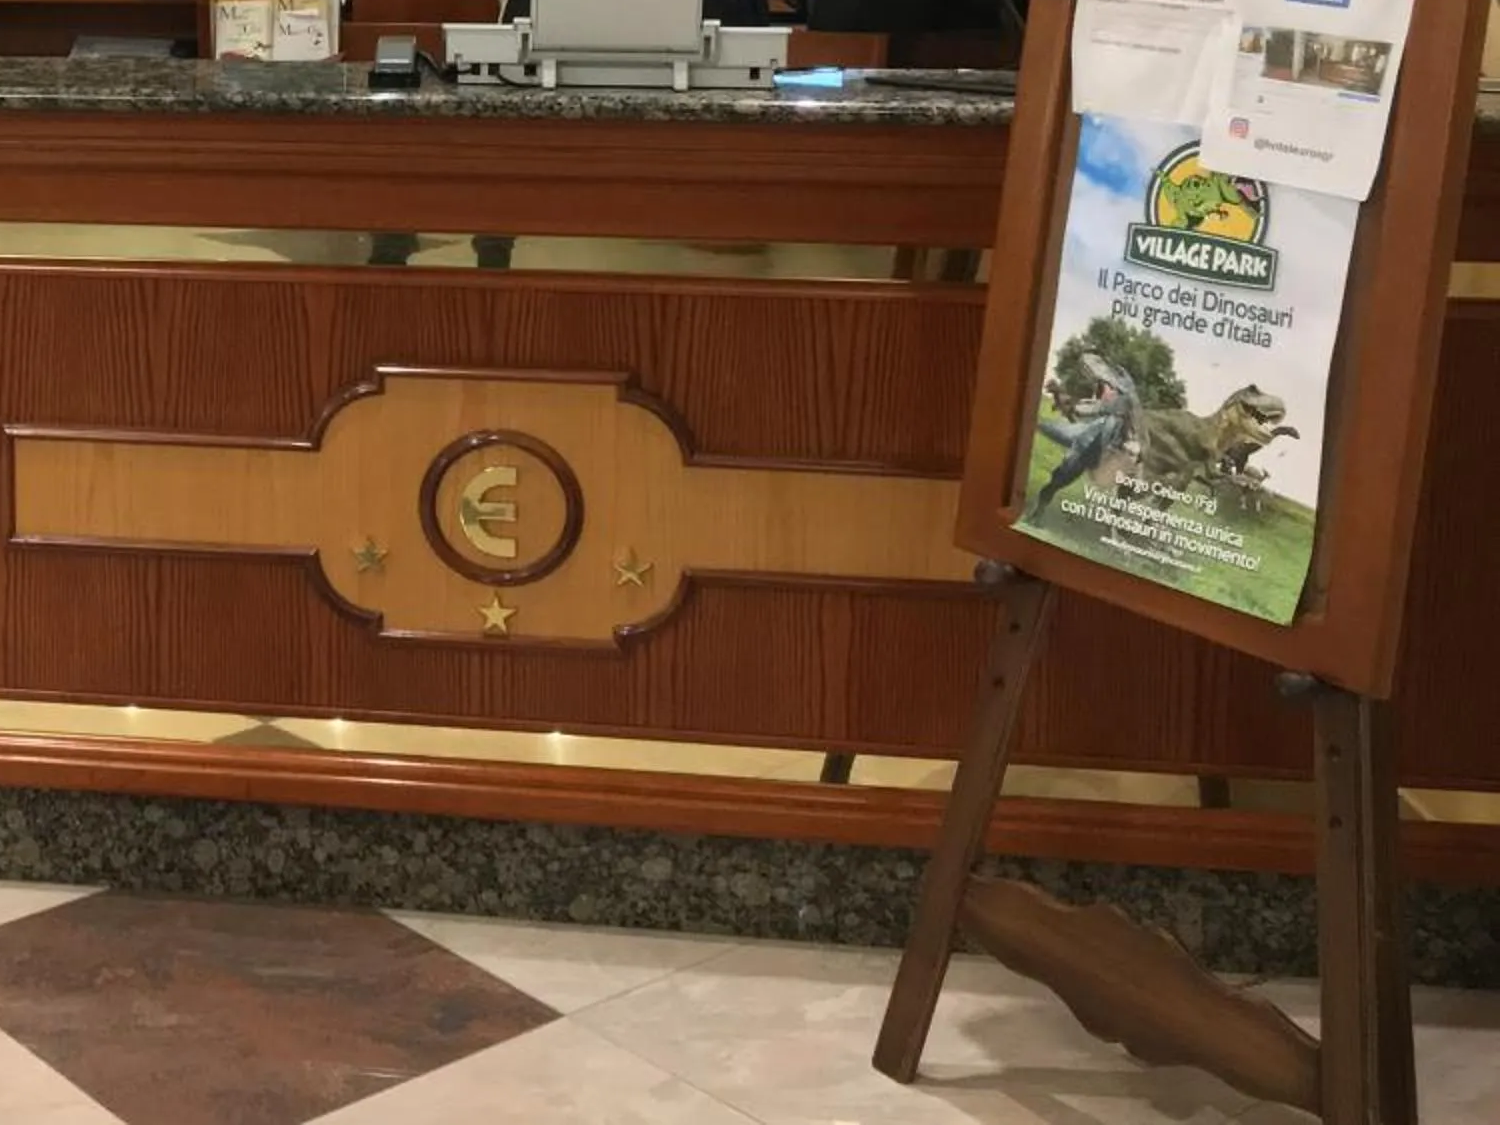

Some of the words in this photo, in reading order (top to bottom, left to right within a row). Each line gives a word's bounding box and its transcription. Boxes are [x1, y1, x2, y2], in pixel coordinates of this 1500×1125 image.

[1136, 235, 1210, 269] VILLAGE
[1211, 247, 1267, 277] PARK
[1097, 267, 1109, 290] Il
[1113, 272, 1163, 300] Parco
[1168, 282, 1198, 308] dei
[1202, 290, 1294, 329] Dinosauri
[1142, 306, 1208, 333] grande
[1212, 317, 1272, 348] d'Italia
[1060, 499, 1086, 517] con
[1095, 506, 1158, 540] Dinosauri
[1158, 527, 1174, 544] in
[1174, 534, 1260, 570] movimento!
[1083, 483, 1108, 505] Vivi
[1109, 492, 1203, 534] un'esperienza
[1205, 525, 1244, 548] unica
